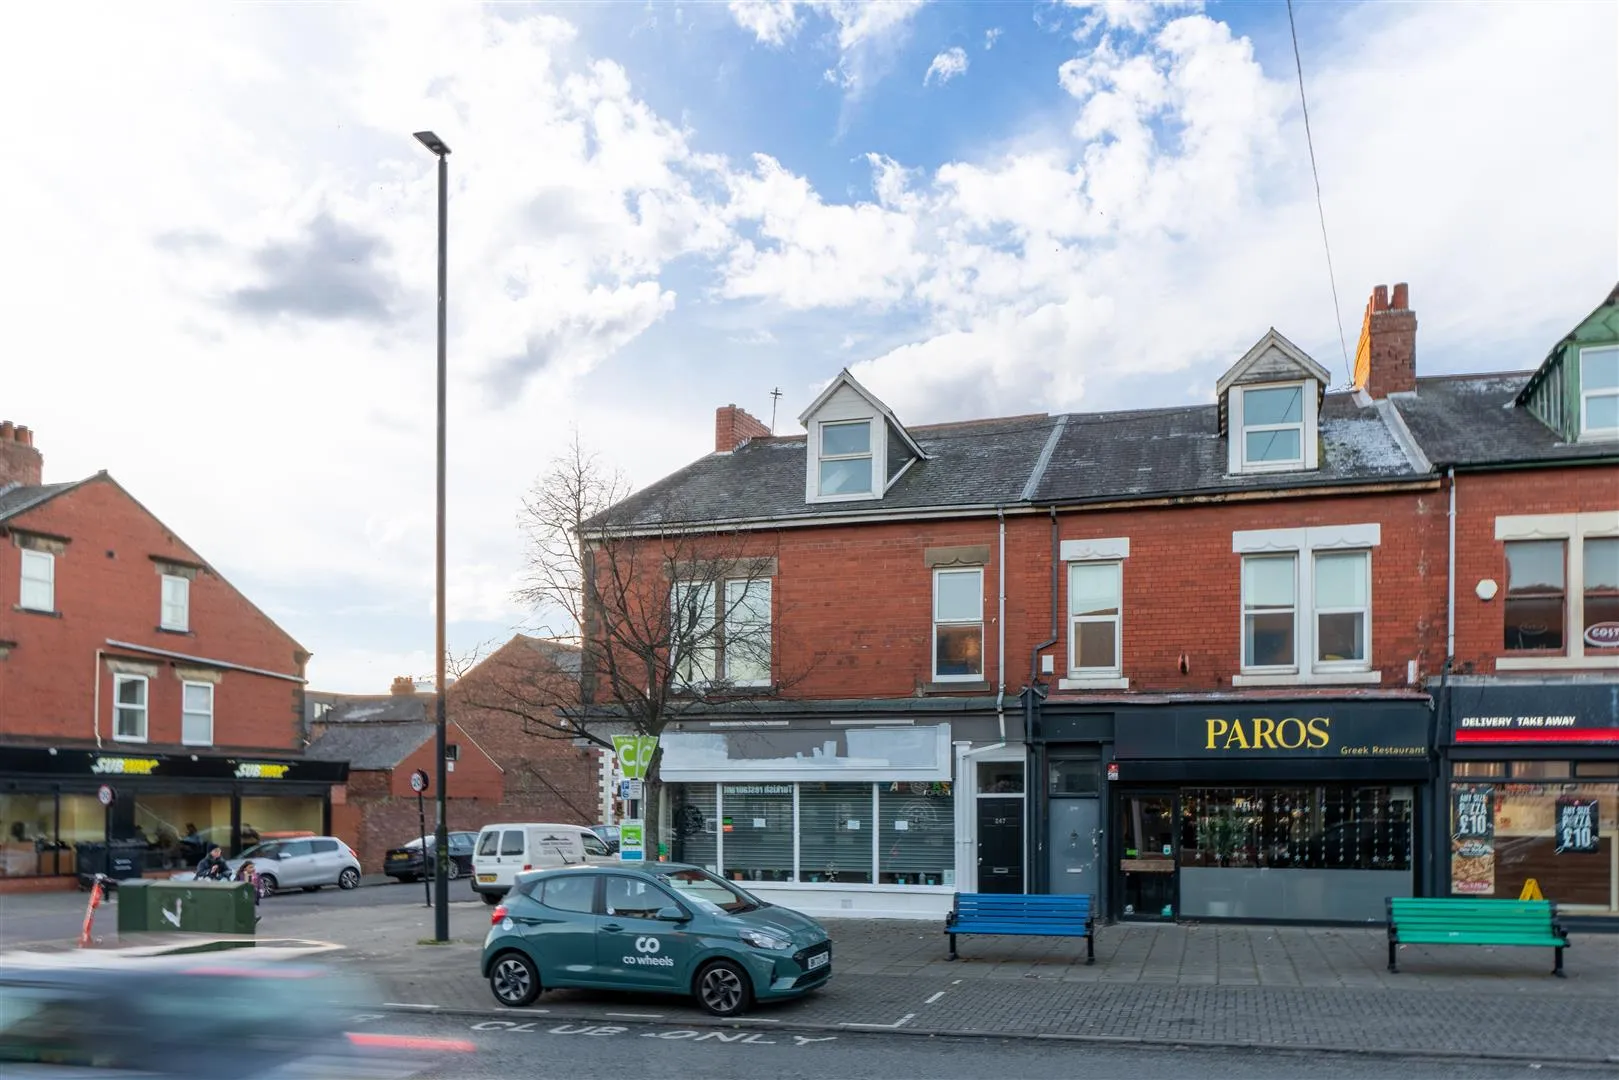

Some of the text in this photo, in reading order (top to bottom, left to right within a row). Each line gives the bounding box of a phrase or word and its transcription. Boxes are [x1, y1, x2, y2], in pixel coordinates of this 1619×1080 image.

[1462, 716, 1576, 728] DELIVERY TAKE AWAY
[1205, 717, 1330, 750] PAROS
[1341, 745, 1425, 754] Greek Restaurant
[90, 757, 160, 775] SUBWAY
[233, 763, 290, 779] SUBWAY
[1460, 814, 1487, 834] £10
[1562, 827, 1591, 848] £10
[636, 955, 674, 967] wheels
[471, 1021, 837, 1045] CLUB ONLY
